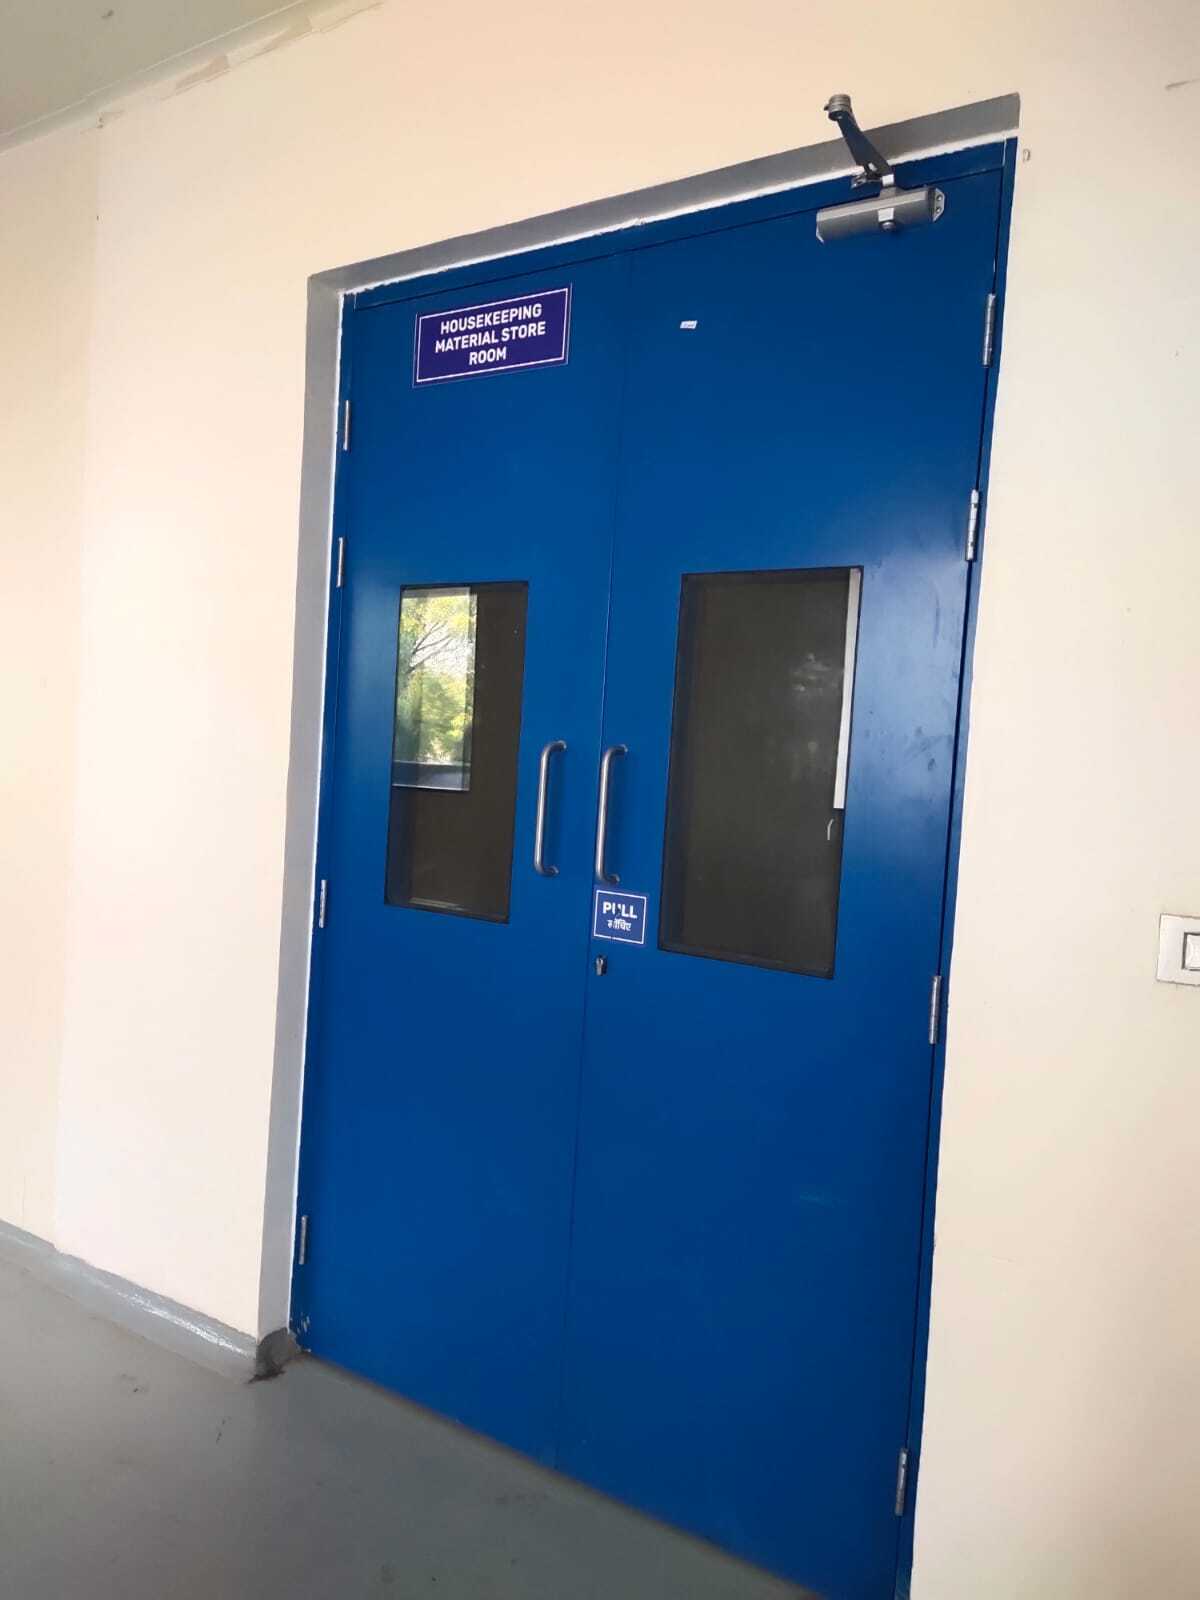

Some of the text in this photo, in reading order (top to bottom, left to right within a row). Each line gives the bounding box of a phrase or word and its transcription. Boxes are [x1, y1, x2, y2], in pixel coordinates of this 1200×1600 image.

[440, 303, 543, 335] HOUSEKEEPING
[435, 321, 546, 354] MATERIAL STORE
[468, 346, 508, 366] ROOM
